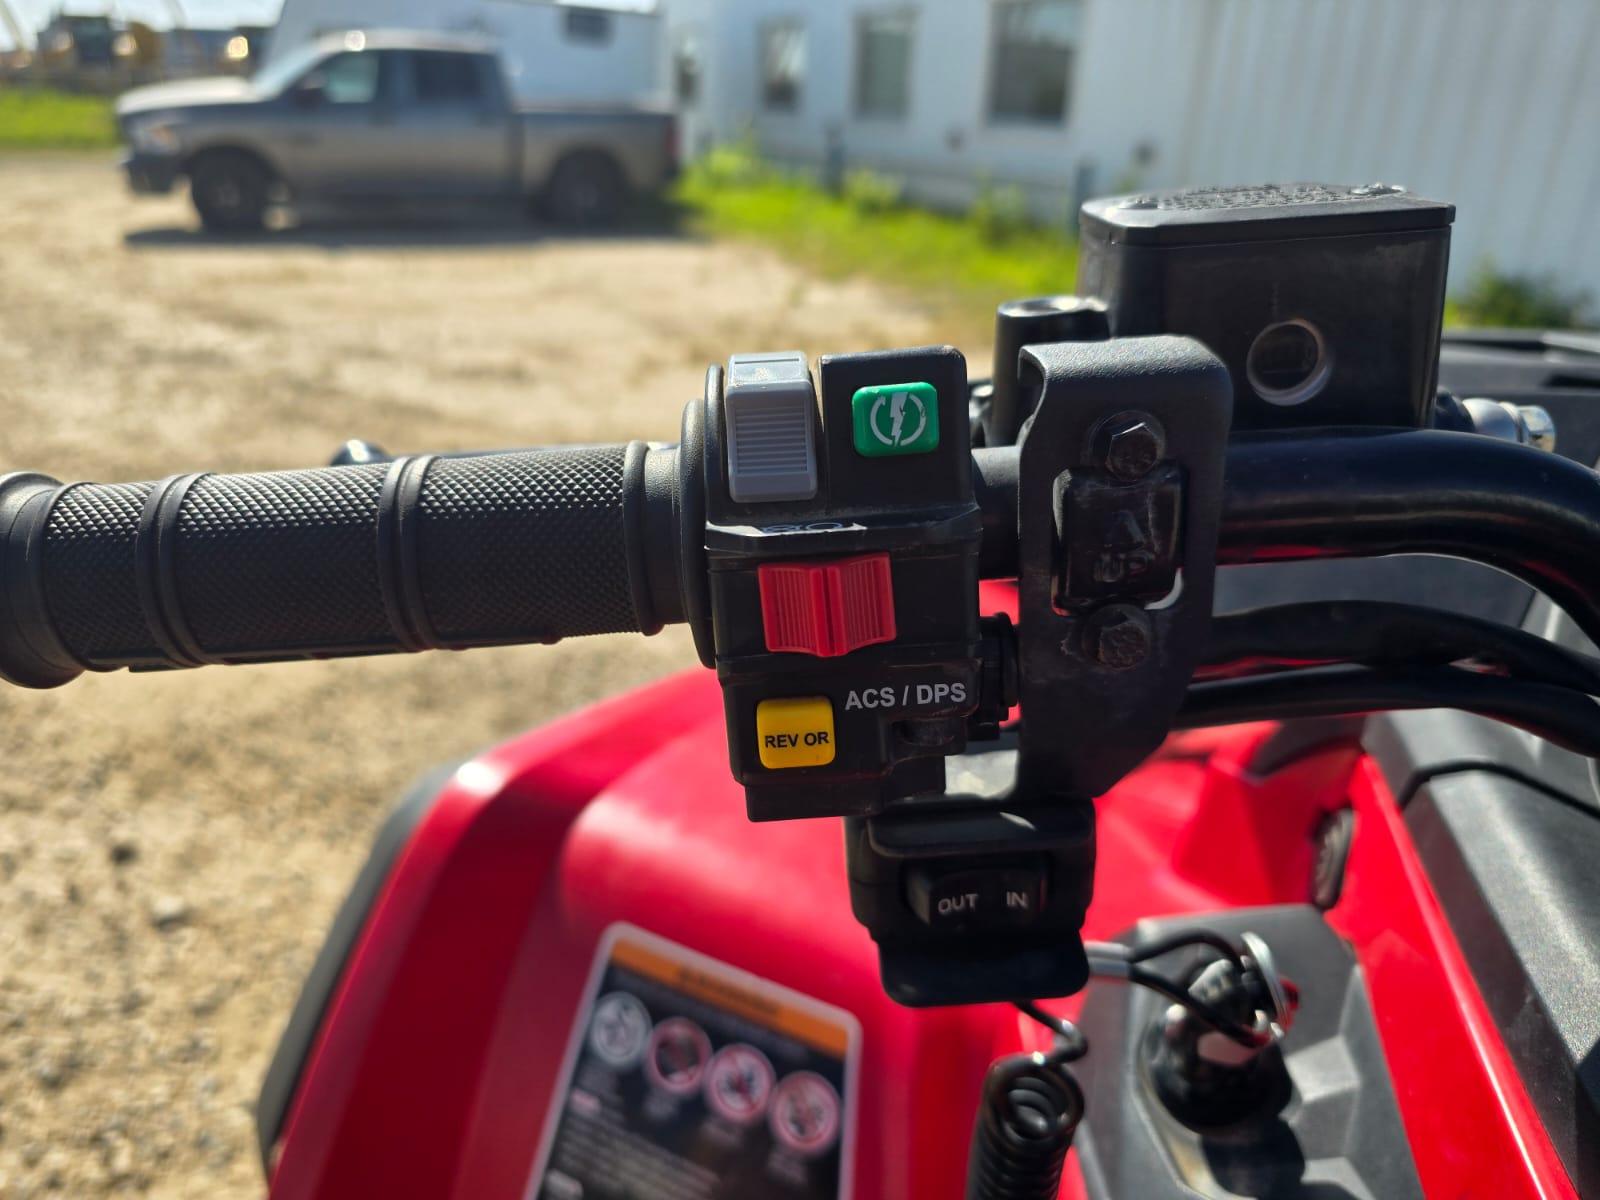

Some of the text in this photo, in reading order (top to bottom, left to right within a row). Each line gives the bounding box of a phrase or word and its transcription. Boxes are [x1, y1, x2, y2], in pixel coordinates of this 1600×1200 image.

[845, 687, 896, 711] ACS
[916, 683, 967, 704] DPS
[764, 731, 829, 748] REV OR
[937, 891, 1028, 915] OUT IN
